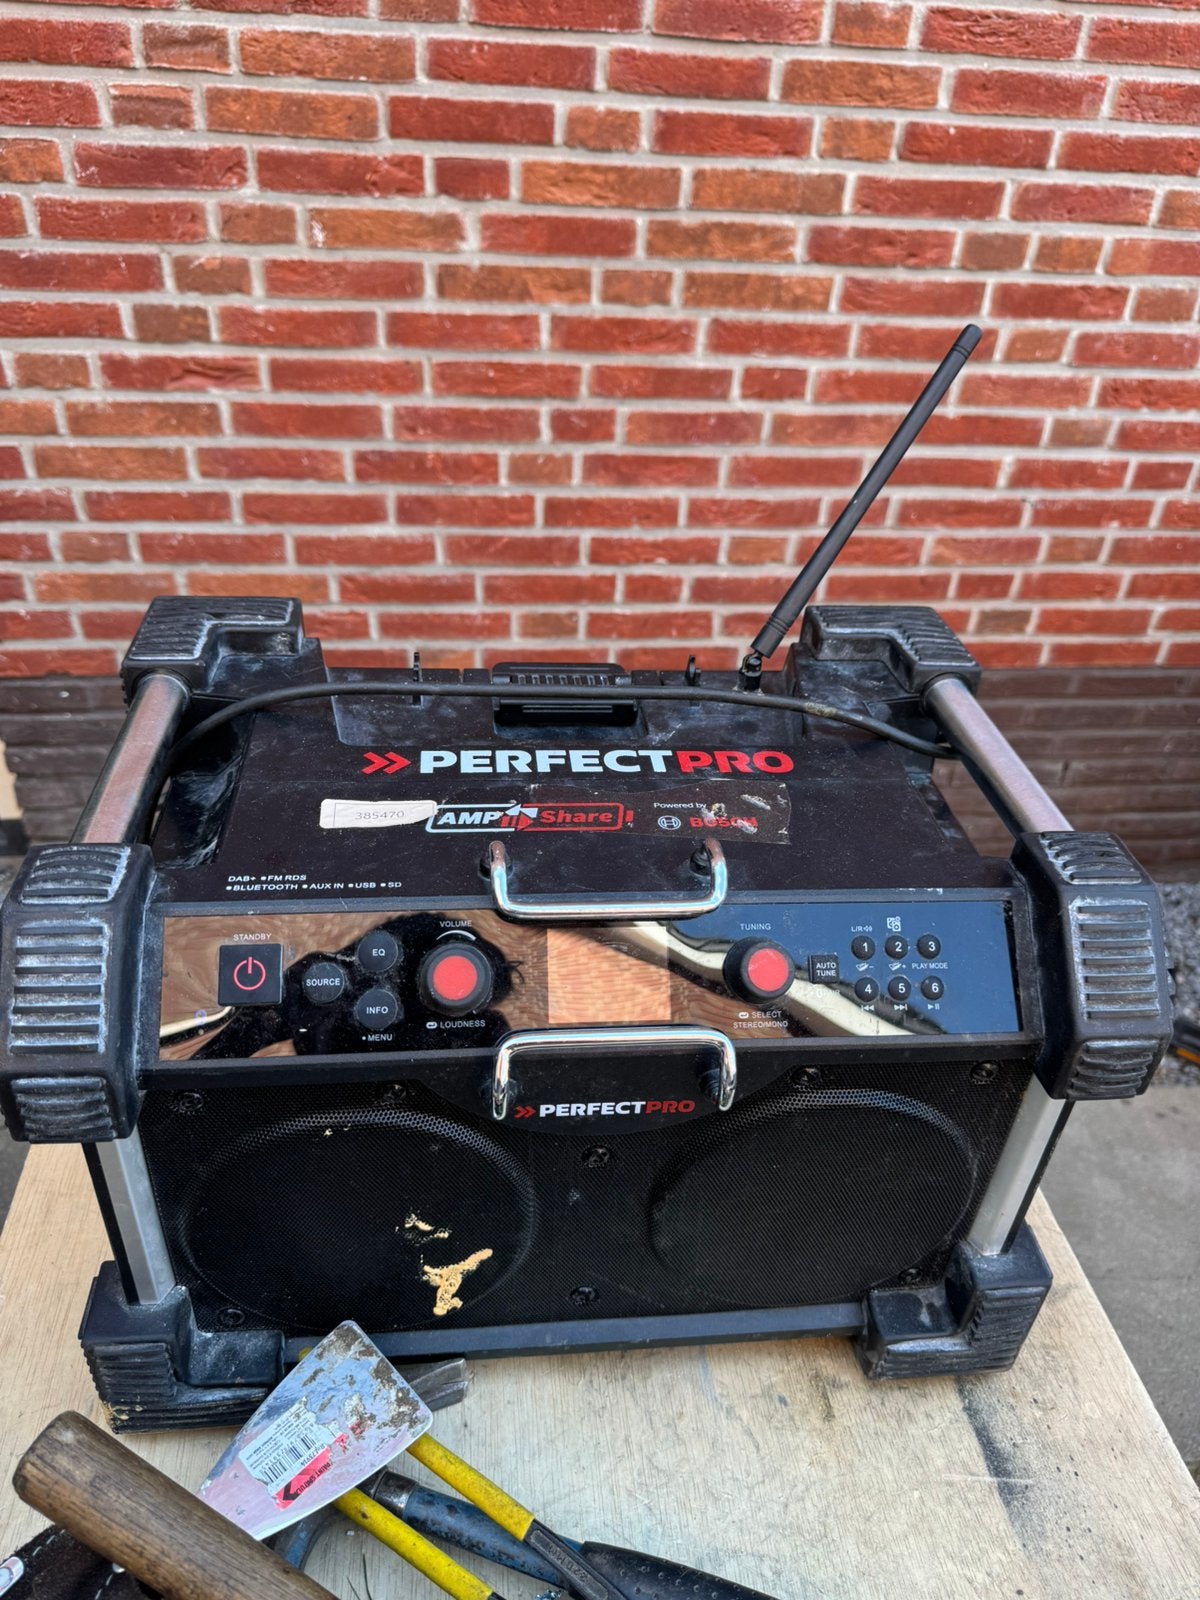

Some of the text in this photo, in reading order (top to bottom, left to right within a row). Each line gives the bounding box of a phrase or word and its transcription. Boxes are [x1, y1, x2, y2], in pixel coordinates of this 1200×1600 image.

[419, 749, 795, 775] PERFECTPRO
[696, 802, 706, 811] by
[354, 810, 405, 821] 385470
[437, 811, 499, 825] AMP
[228, 875, 256, 883] DAB+
[233, 884, 298, 892] BLUETOOTH
[439, 920, 472, 928] VOLUME
[740, 923, 772, 931] TUNING
[233, 933, 272, 941] STANDBY
[862, 942, 869, 953] 1
[894, 941, 903, 953] 2
[928, 941, 937, 952] 3
[372, 949, 386, 959] EQ
[306, 977, 341, 987] SOURCE
[864, 983, 873, 995] 4
[898, 982, 906, 994] 5
[931, 982, 940, 993] 6
[366, 1005, 389, 1015] INFO
[751, 1010, 782, 1018] SELECT
[440, 1020, 486, 1029] LOUDNESS
[732, 1020, 788, 1028] STEREO/MONO
[367, 1033, 393, 1042] MENU
[539, 1101, 696, 1117] PERFECTPRO
